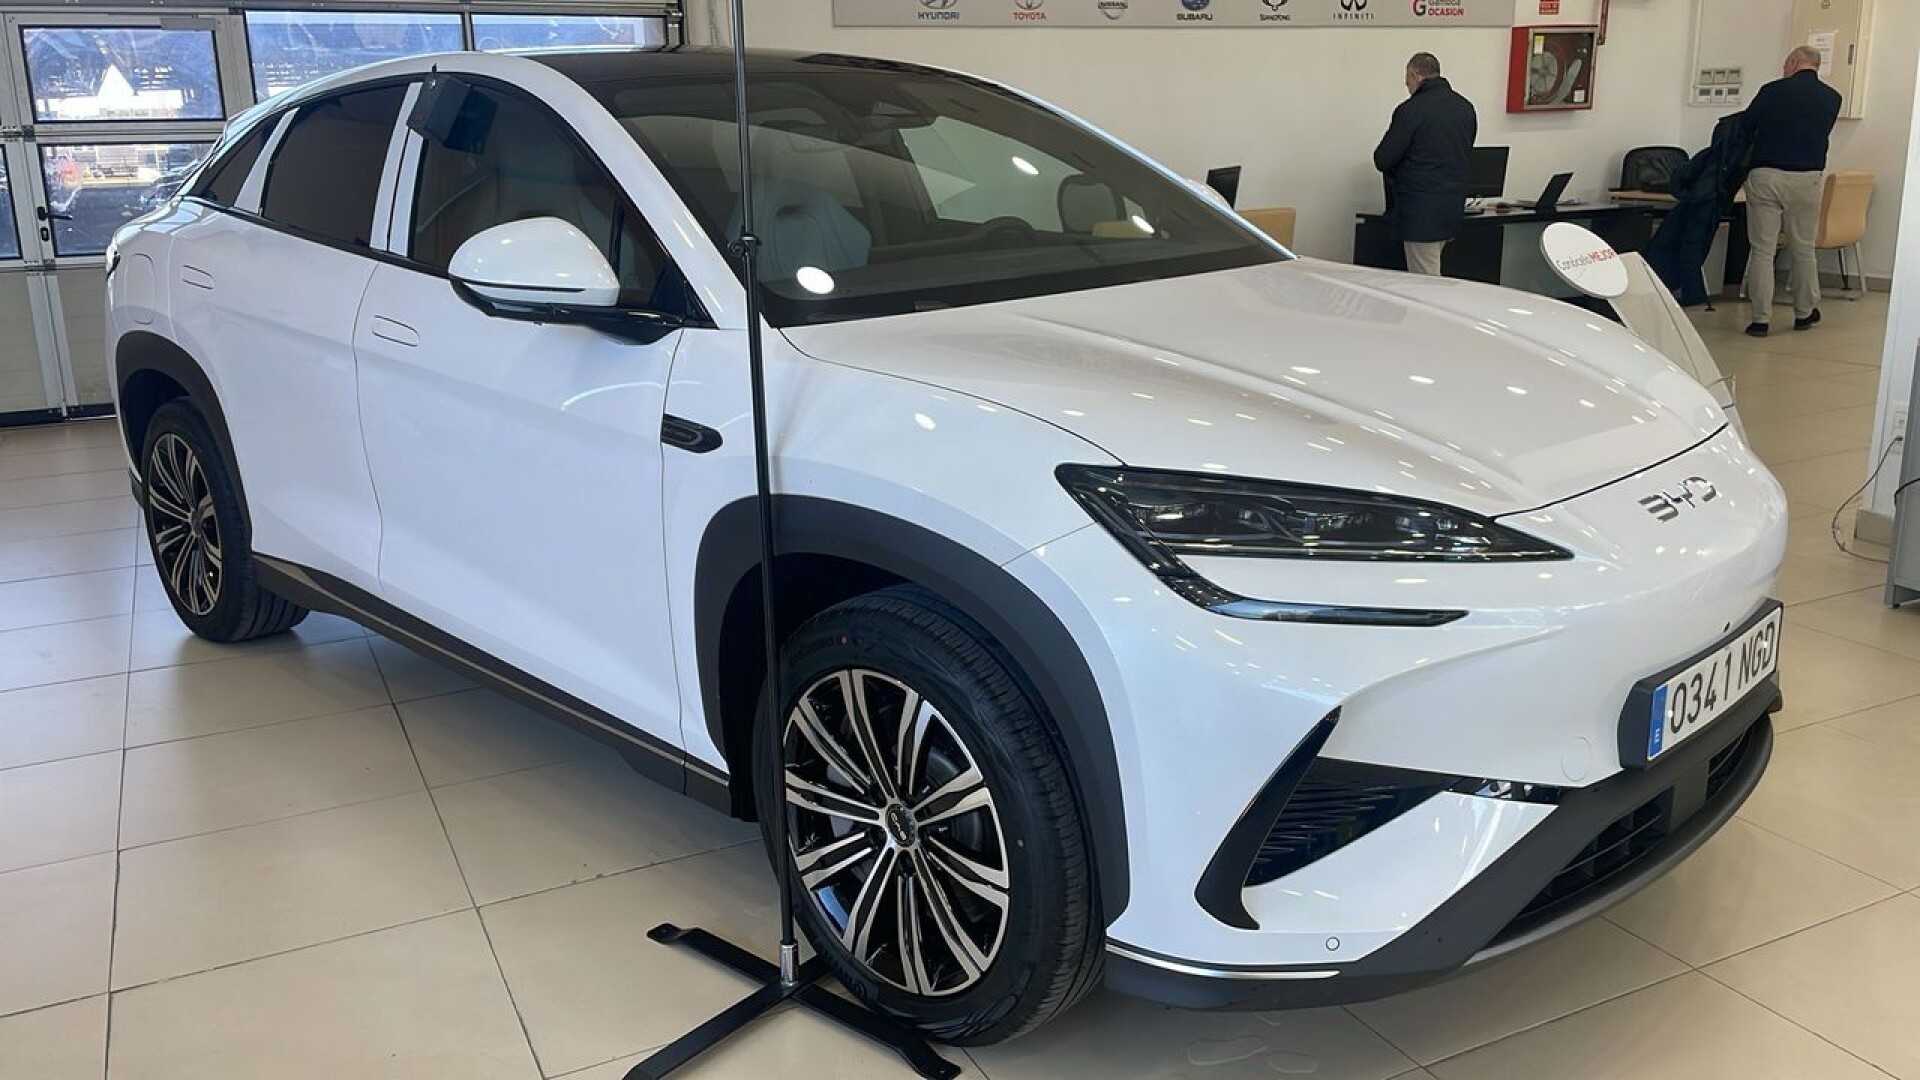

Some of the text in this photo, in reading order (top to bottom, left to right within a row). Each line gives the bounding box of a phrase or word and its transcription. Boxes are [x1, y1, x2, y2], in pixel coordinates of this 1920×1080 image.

[917, 12, 960, 20] HYUNDAI
[1013, 12, 1047, 20] TOYOTA
[1637, 476, 1717, 524] BYD
[1669, 620, 1776, 735] 0341 NGD
